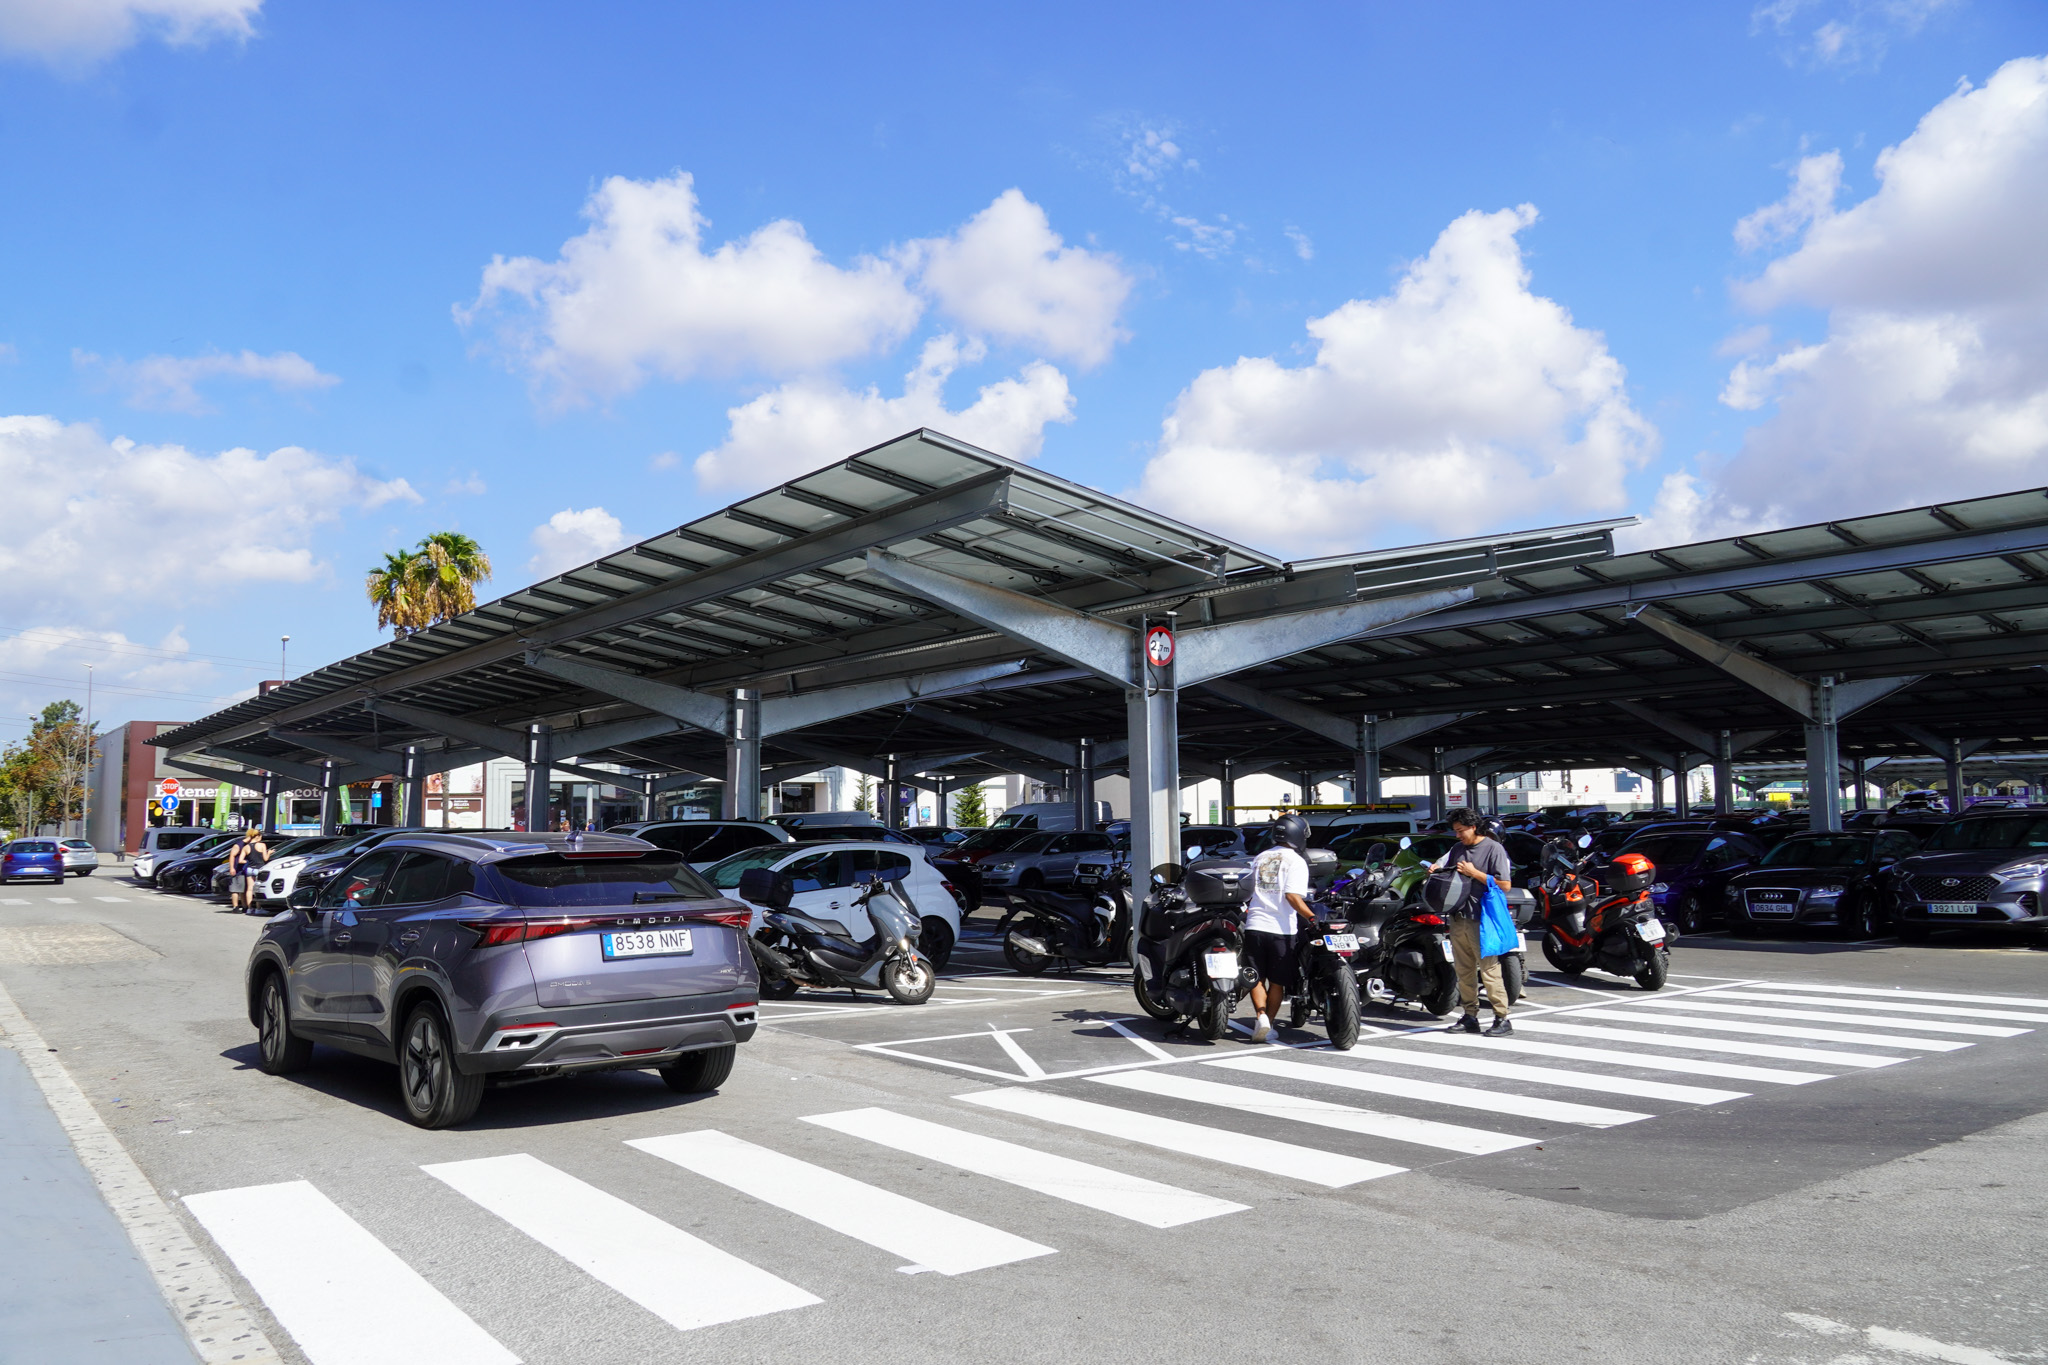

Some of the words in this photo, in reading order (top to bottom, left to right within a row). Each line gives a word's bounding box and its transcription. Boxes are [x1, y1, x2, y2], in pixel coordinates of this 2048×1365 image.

[233, 785, 258, 798] les
[1755, 904, 1774, 912] 0634
[1775, 904, 1790, 912] GHL
[1933, 904, 1955, 913] 3921
[1957, 904, 1974, 913] LGV
[616, 915, 685, 925] OMODA
[615, 934, 655, 951] 8538
[659, 932, 686, 948] NNF
[550, 980, 585, 988] OMODA
